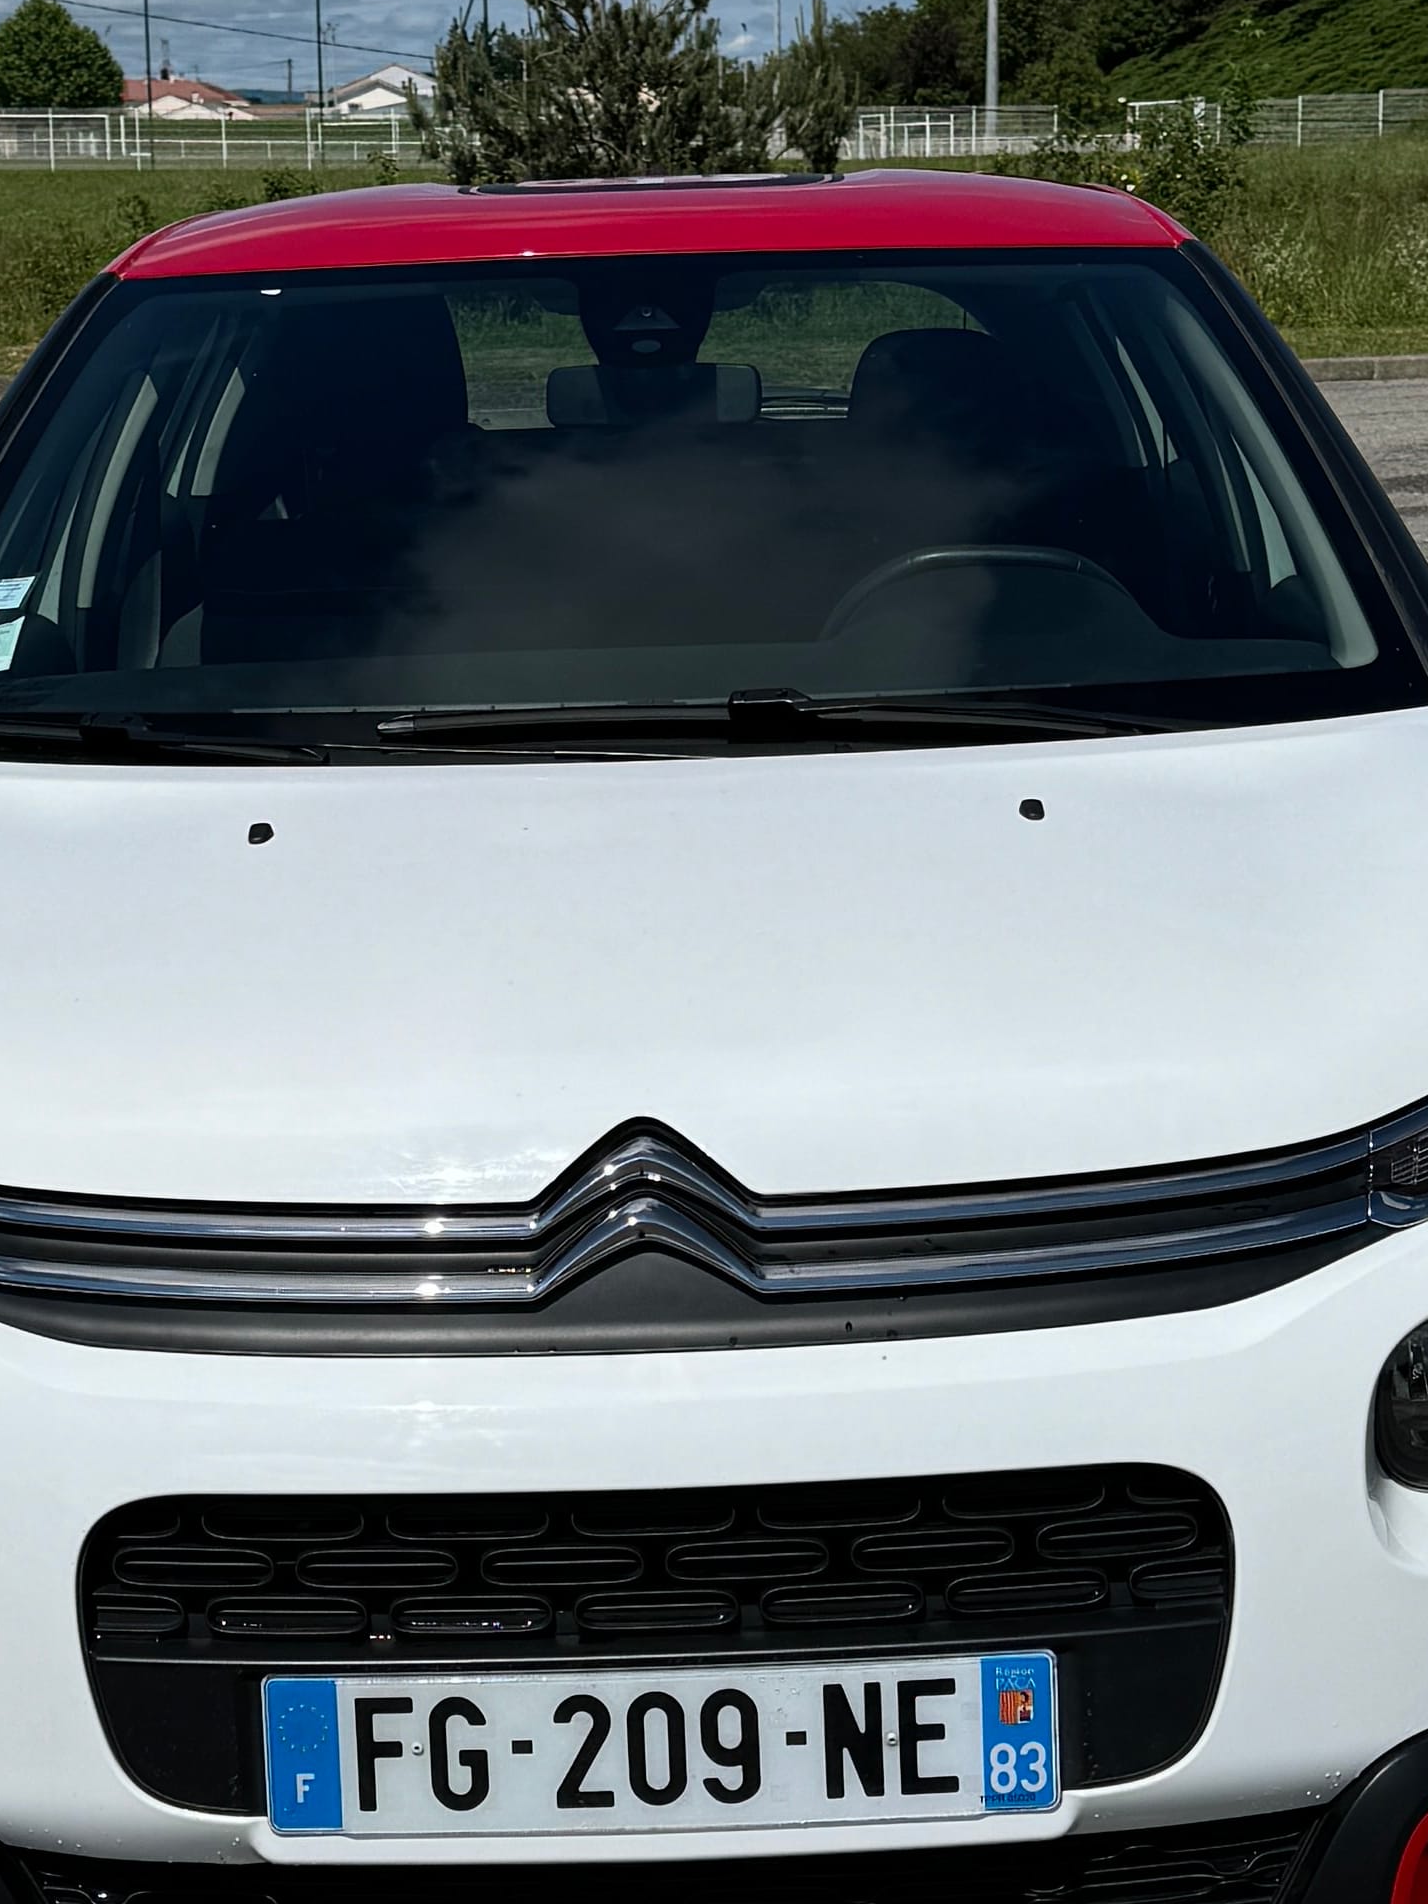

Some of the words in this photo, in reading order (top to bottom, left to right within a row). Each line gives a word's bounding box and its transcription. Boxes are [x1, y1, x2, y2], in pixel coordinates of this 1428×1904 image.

[995, 1677, 1036, 1691] PACA
[354, 1678, 960, 1812] FG-209-NE
[990, 1741, 1047, 1793] 83
[296, 1773, 315, 1803] F
